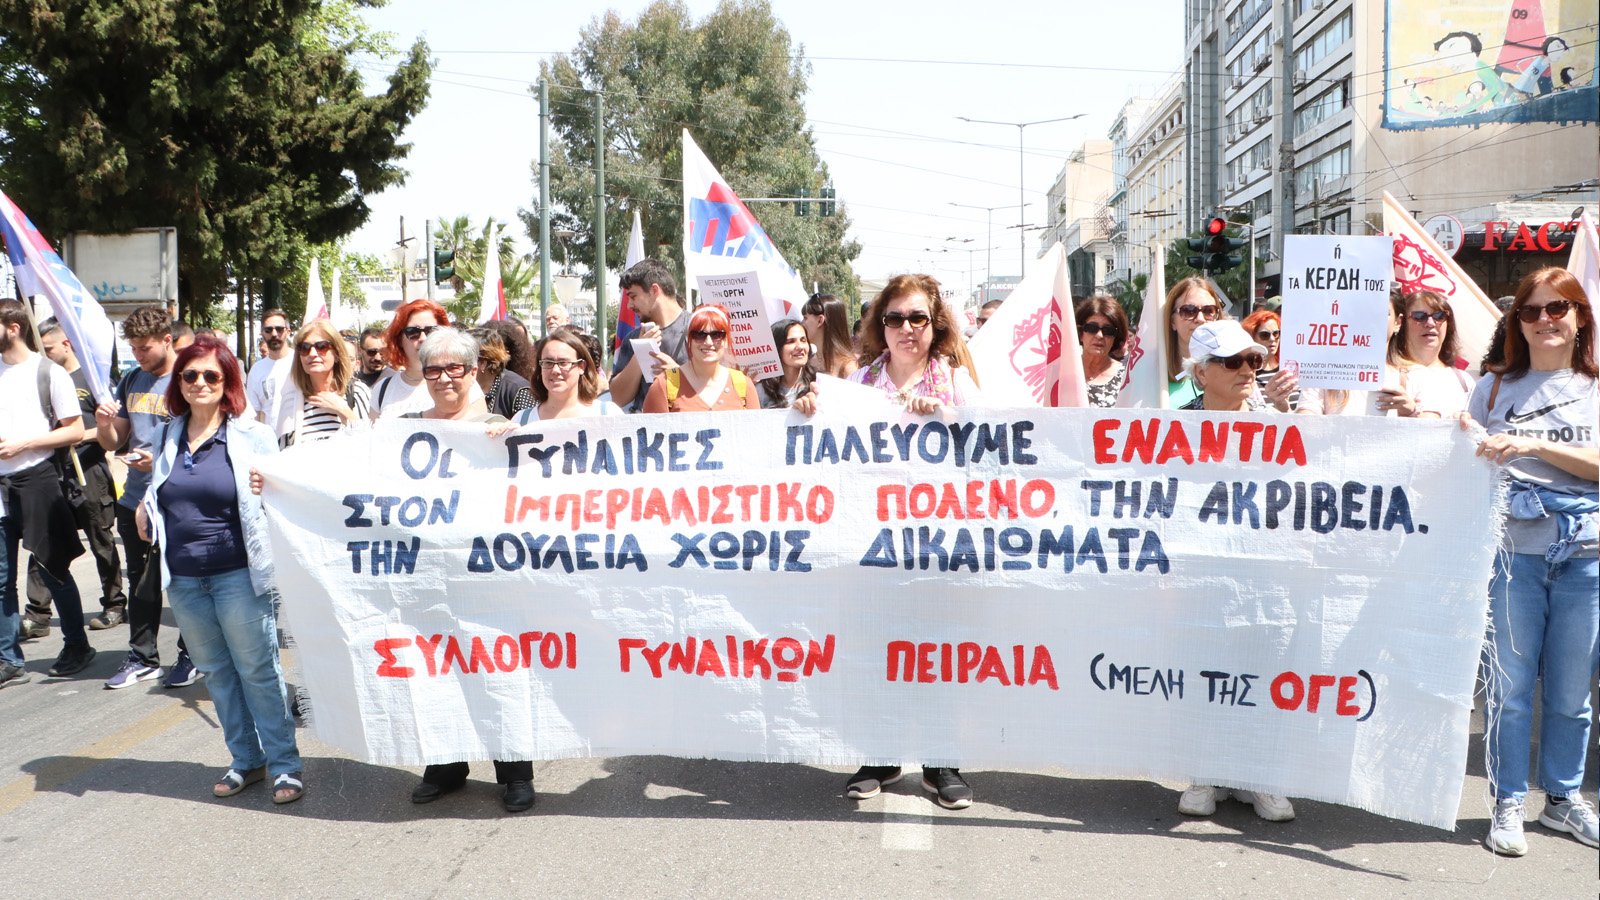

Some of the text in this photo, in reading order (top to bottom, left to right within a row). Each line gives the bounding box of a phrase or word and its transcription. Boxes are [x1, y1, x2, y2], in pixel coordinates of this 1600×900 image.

[1512, 9, 1528, 19] 09
[1334, 244, 1341, 259] ή
[705, 277, 748, 286] ΜΕΤΑΤΡΕΠΟΥΜΕ
[1289, 267, 1384, 291] ΤΑ ΚΕΡΔΗ ΤΟΥΣ
[724, 288, 745, 298] ΟΡΓΗ
[1332, 300, 1338, 315] ή
[735, 336, 751, 344] ΖΩΗ
[1296, 323, 1371, 347] ΟΙ ΖΩΕΣ ΜΑΣ
[734, 345, 773, 357] ΑΙΩΜΑΤΑ
[763, 364, 778, 373] ΟΓΕ
[1359, 371, 1378, 382] ΟΓΕ
[1548, 427, 1573, 442] DO
[1576, 426, 1592, 441] IT
[505, 427, 722, 478] ΓΥΝΑΙΚΕΣ
[786, 421, 1037, 467] ΠΑΛΕΥΟΥΜΕ
[1093, 418, 1307, 466] ΕΝΑΝΤΙΑ
[342, 490, 459, 529] ΣΤΟΝ
[504, 482, 835, 531] ΙΜΠΕΡΙΑΛΙΣΤΙΚΟ
[1081, 477, 1179, 519] ΤΗΝ
[1198, 480, 1428, 534] ΑΚΡΙΒΕΙΑ.
[346, 525, 1170, 576] ΤΗΝ ΔΟΥΛΕΙΑ ΧΩΡΙΣ ΔΙΚΑΙΩΜΑΤΑ
[374, 632, 576, 678] ΣΥΛΛΟΓΟΙ
[619, 634, 835, 682] ΓΥΝΑΙΚΩΝ
[887, 641, 1059, 690] ΠΕΙΡΑΙΑ
[1090, 653, 1184, 701] (ΜΕΛΗ
[1200, 670, 1260, 707] ΤΗΣ
